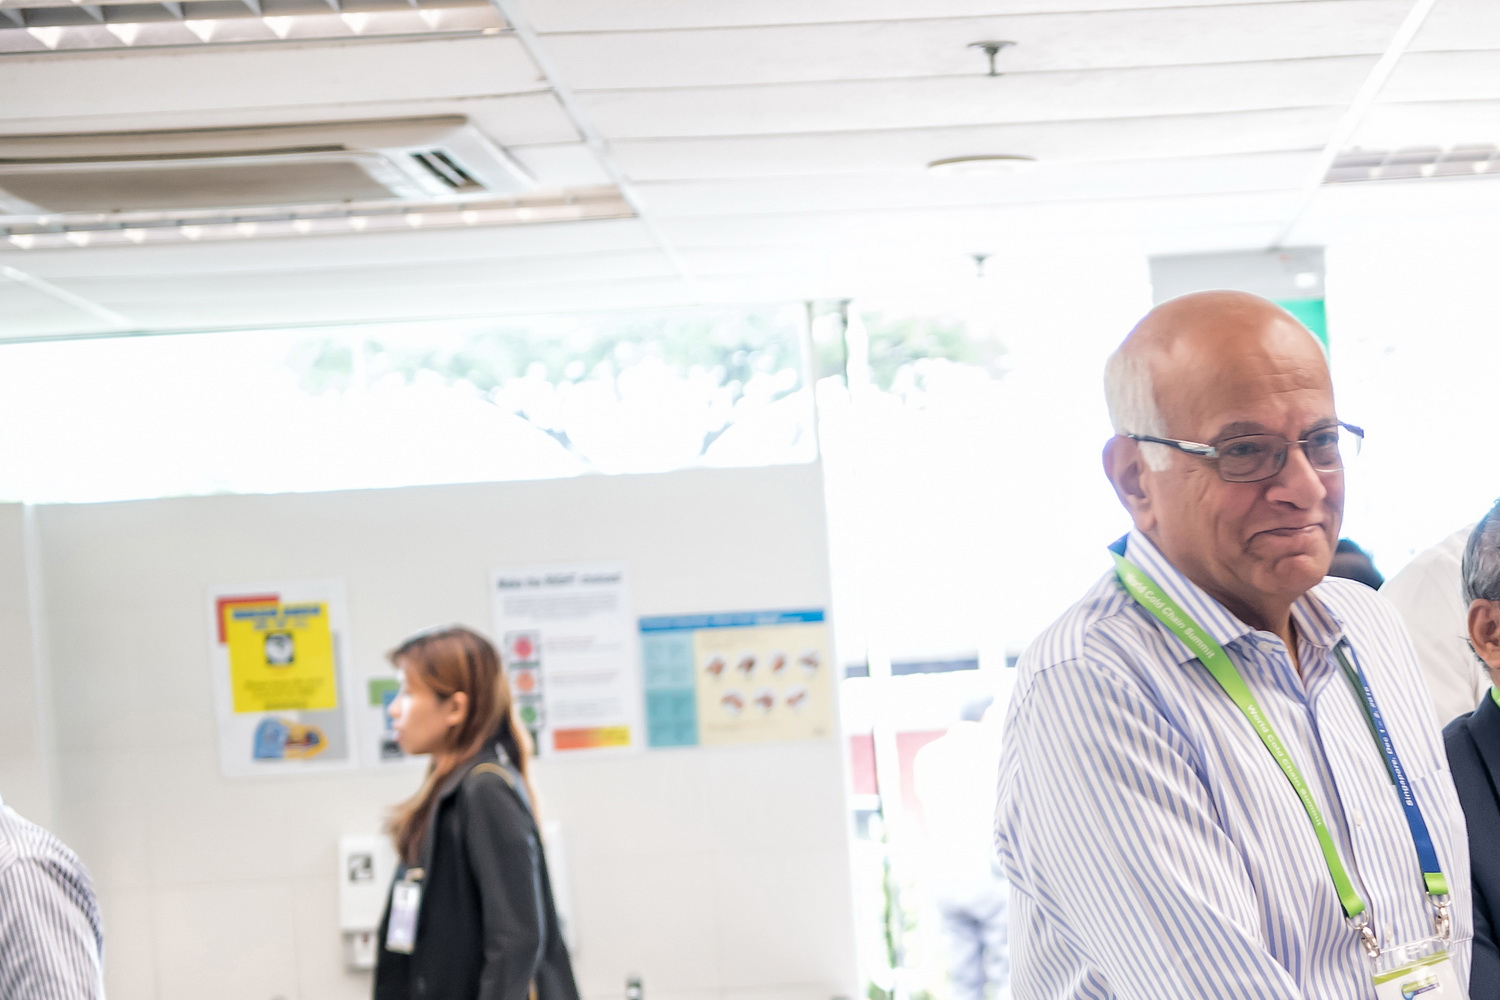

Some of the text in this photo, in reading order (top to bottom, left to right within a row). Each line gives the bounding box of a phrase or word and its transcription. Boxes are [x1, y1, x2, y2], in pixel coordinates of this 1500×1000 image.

[1125, 573, 1215, 658] World Cold Chain Summit
[1247, 704, 1322, 826] World Cold Chain Summit
[1383, 737, 1393, 754] Dec
